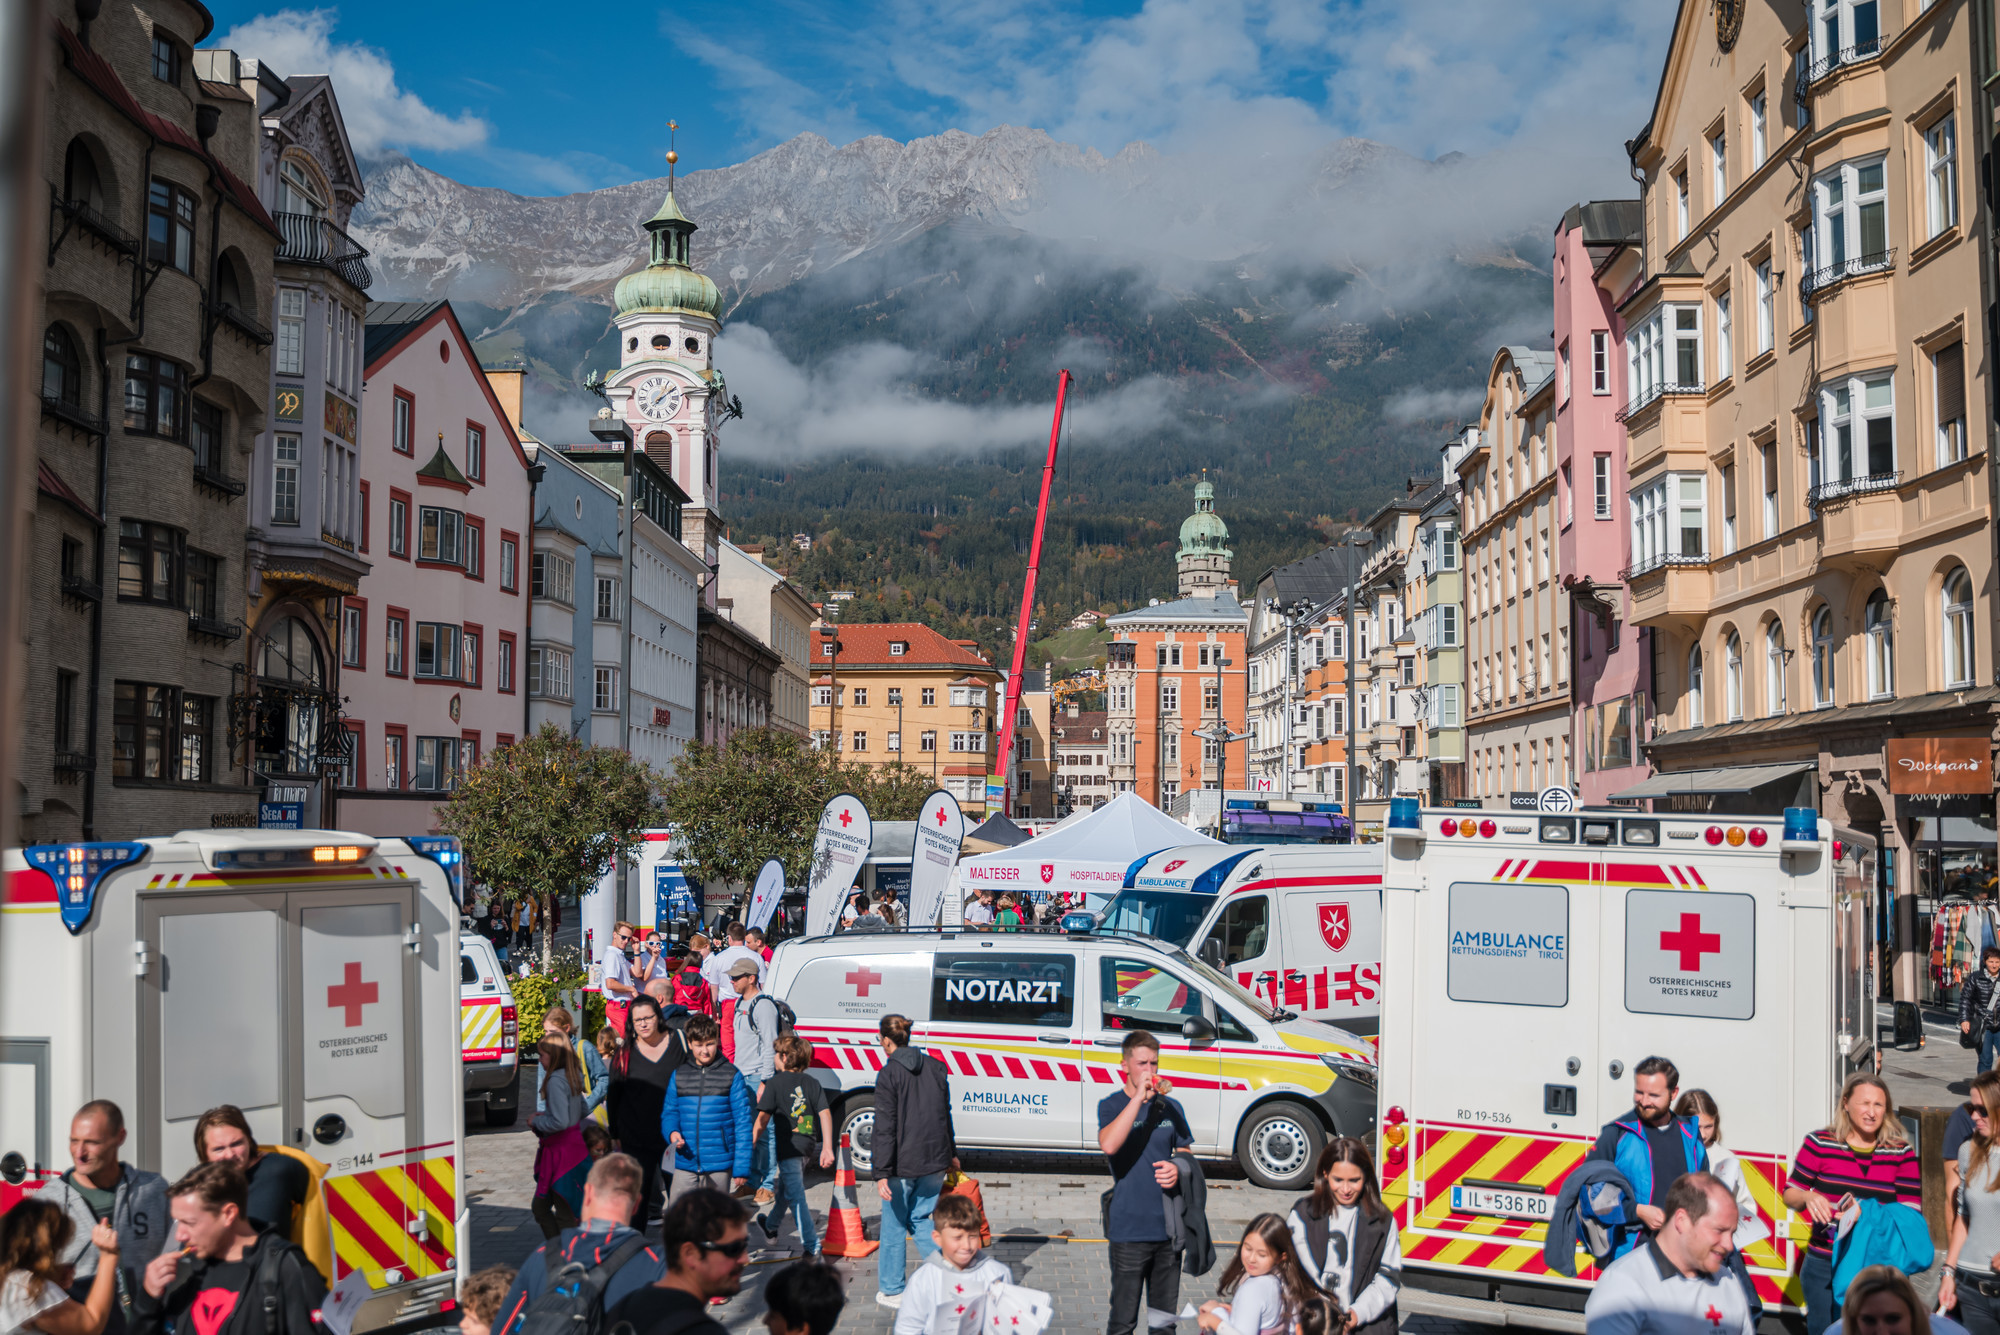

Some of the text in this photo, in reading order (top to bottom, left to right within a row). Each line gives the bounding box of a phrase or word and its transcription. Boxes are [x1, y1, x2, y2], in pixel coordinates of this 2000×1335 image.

[317, 756, 350, 766] STAGE12
[1898, 758, 1983, 775] Weigand
[1511, 797, 1537, 806] ecco
[825, 838, 859, 854] ROTES KREUZ
[924, 837, 953, 855] ROTES KREUZ
[969, 867, 1020, 881] MALTESER
[1070, 870, 1127, 882] HOSPITALDIENS
[1138, 878, 1187, 888] AMBULANCE
[1452, 930, 1565, 951] AMBULANCE
[1451, 946, 1565, 960] RETTUNGSDIENST TIROL
[1648, 976, 1732, 989] ÖSTERREICHISCHES
[945, 978, 1062, 1003] NOTARZT
[1661, 987, 1719, 998] ROTES KREUZ
[319, 1033, 388, 1049] ÖSTERREICHISCHES
[331, 1045, 378, 1059] ROTES KREUZ
[462, 1050, 497, 1058] rantwortung
[962, 1091, 1049, 1106] AMBULANCE
[962, 1104, 1048, 1115] RETTUNGSDIENST TIROL
[1457, 1109, 1512, 1124] RD 19-536
[352, 1152, 374, 1168] 144
[1468, 1191, 1547, 1215] IL 536 RD
[133, 1212, 149, 1236] S
